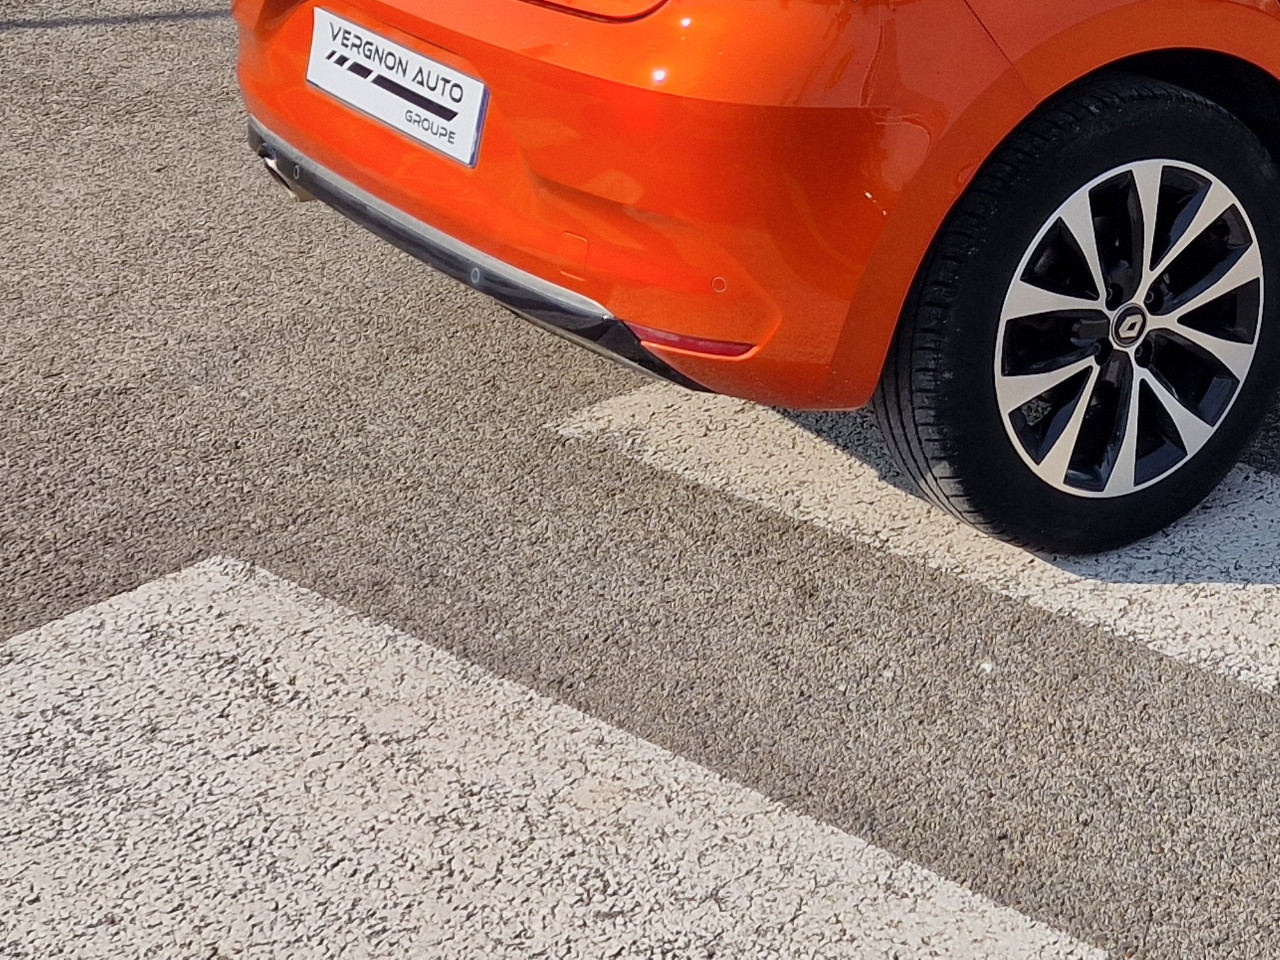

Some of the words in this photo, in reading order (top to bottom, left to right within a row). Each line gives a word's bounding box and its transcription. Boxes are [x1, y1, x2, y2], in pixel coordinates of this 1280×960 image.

[329, 21, 409, 78] VERGNON
[411, 66, 464, 104] AUTO
[404, 109, 457, 144] GROUPE
